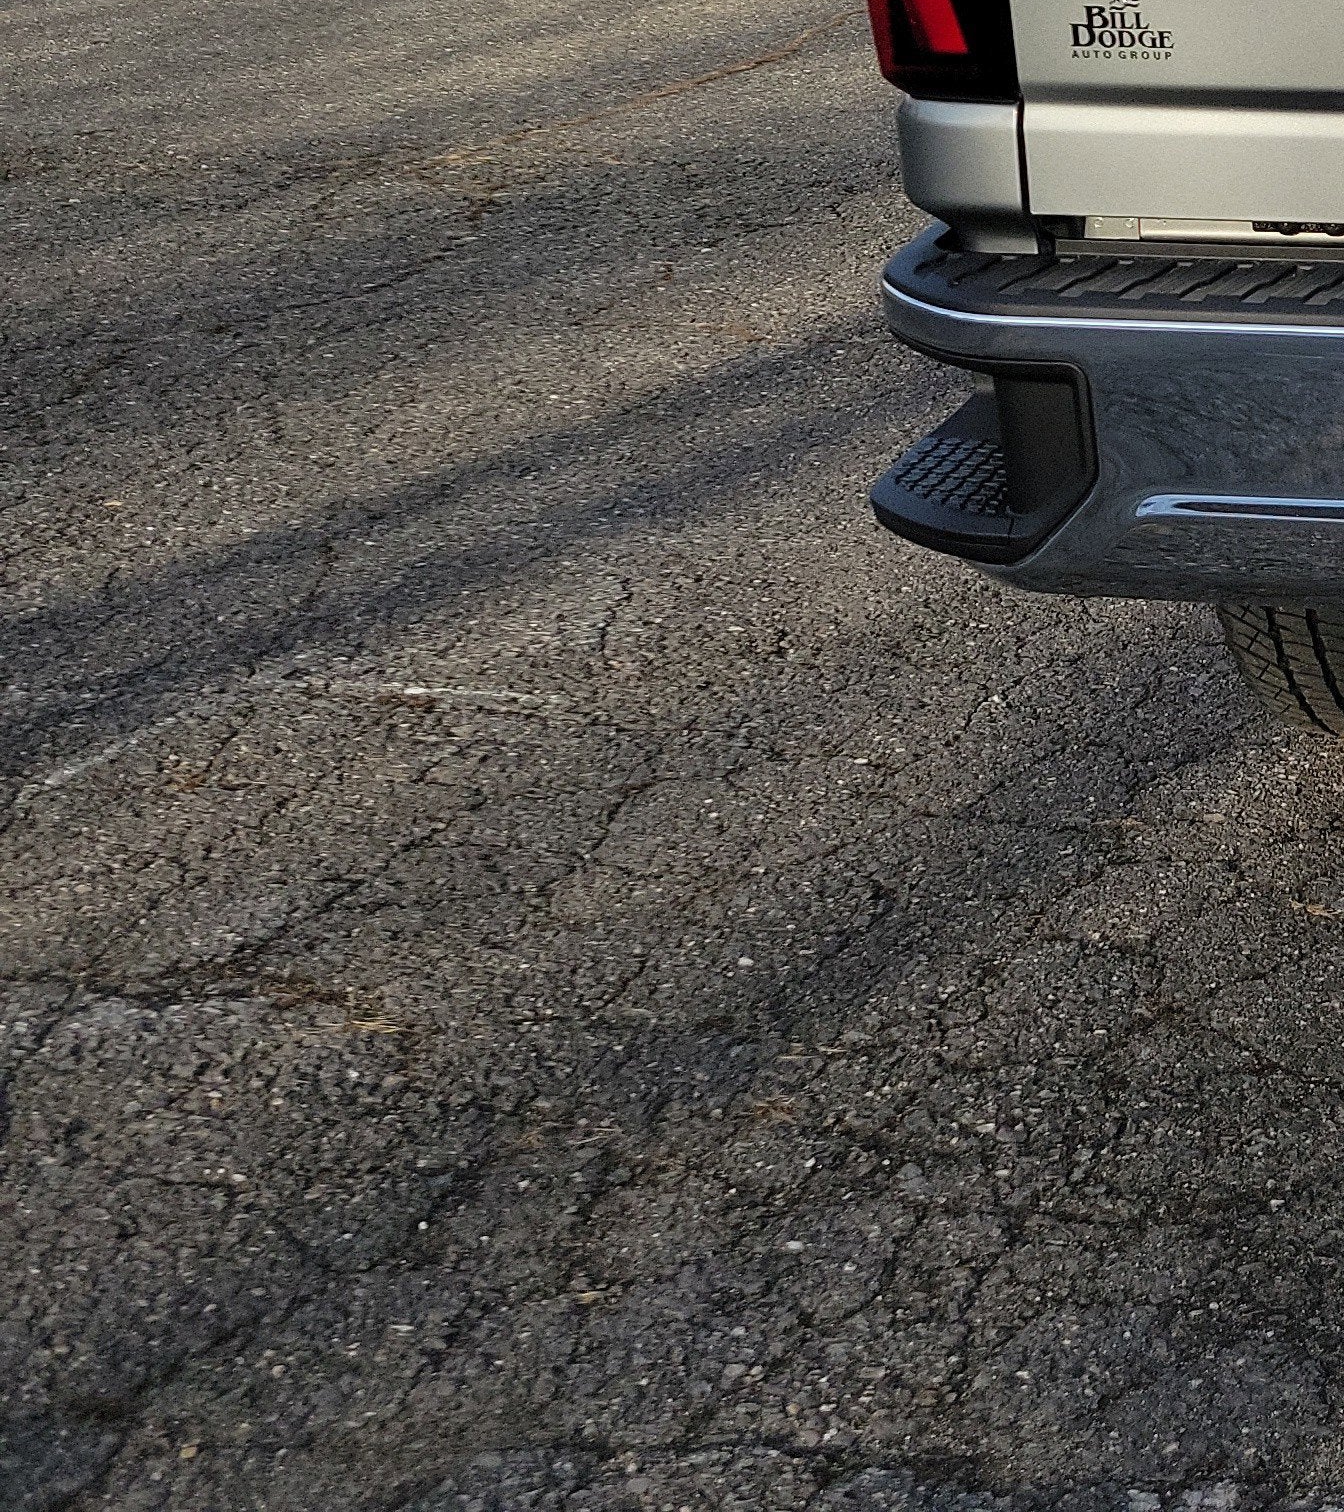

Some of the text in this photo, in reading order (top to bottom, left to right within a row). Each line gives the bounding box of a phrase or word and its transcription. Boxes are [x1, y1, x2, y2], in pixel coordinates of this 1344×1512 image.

[1083, 4, 1150, 30] BILL
[1069, 22, 1175, 49] DODGE
[1071, 49, 1173, 61] AUTO GROUP
